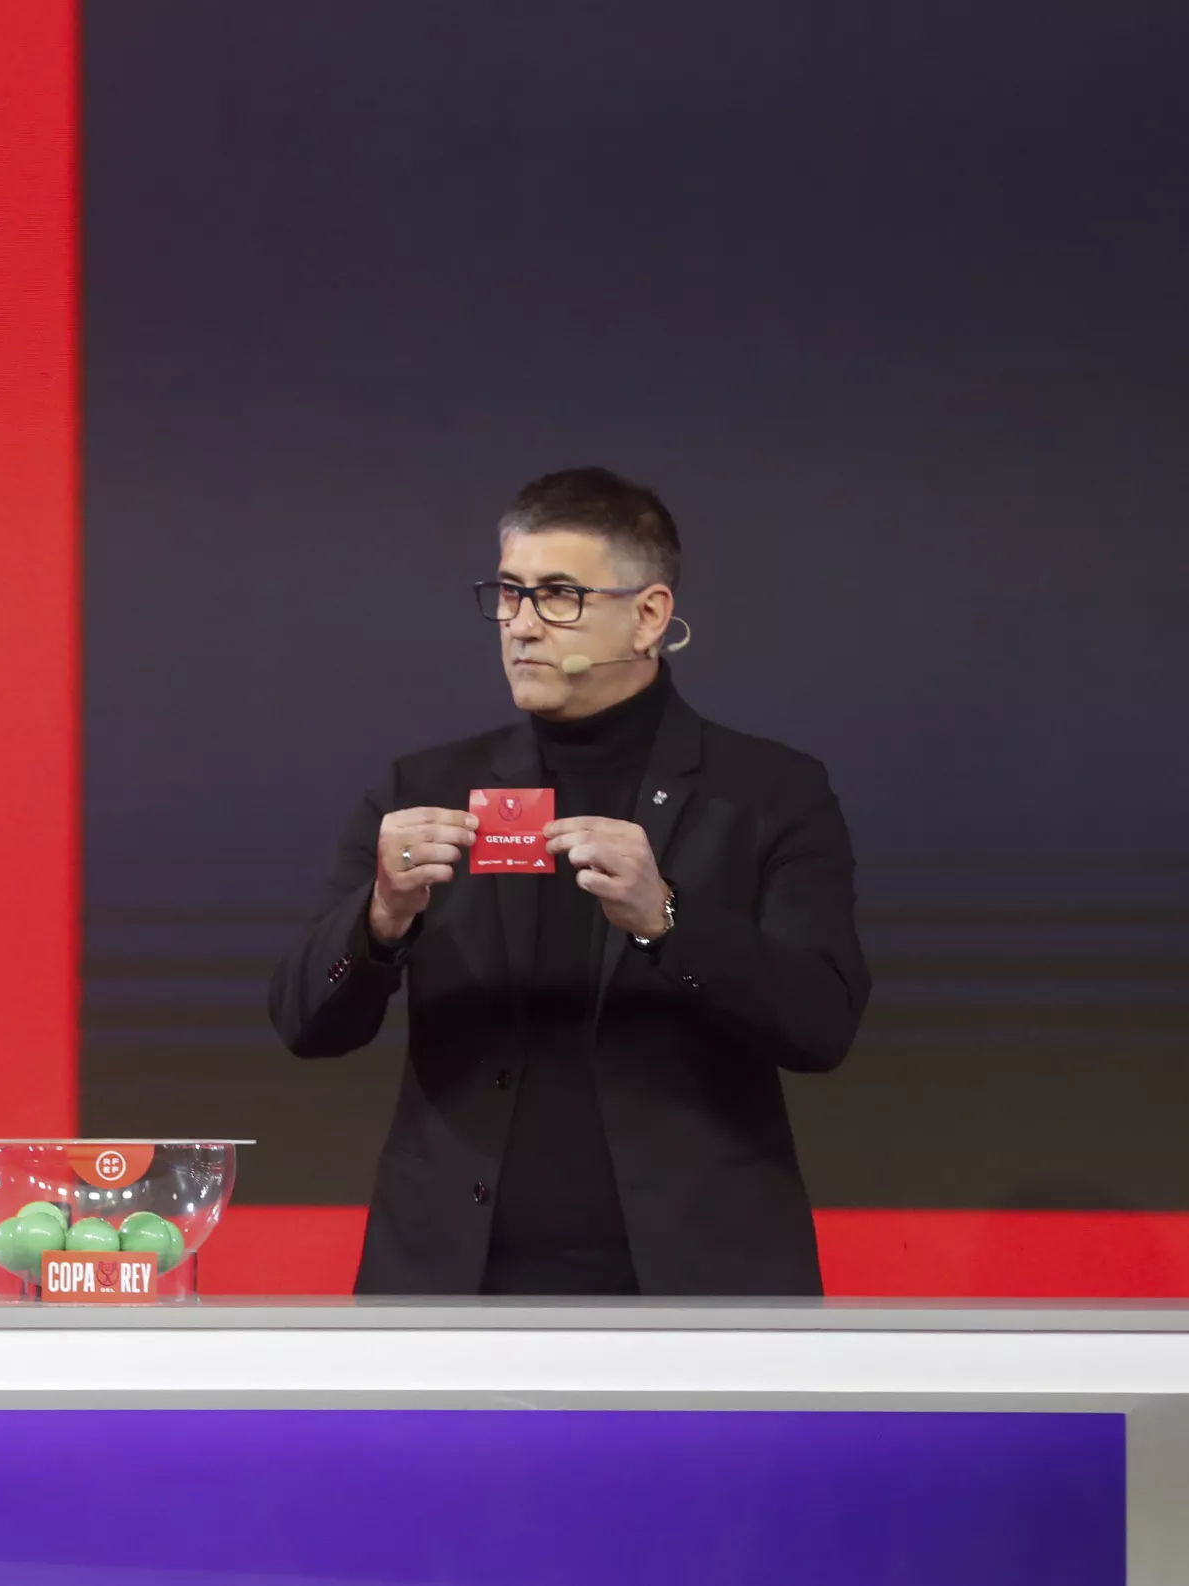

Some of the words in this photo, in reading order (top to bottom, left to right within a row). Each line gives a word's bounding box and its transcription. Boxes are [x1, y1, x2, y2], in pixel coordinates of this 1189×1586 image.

[485, 835, 522, 844] GETAFE
[522, 836, 536, 844] CF
[103, 1157, 119, 1165] RF
[48, 1261, 96, 1293] COPA
[120, 1262, 152, 1293] REY
